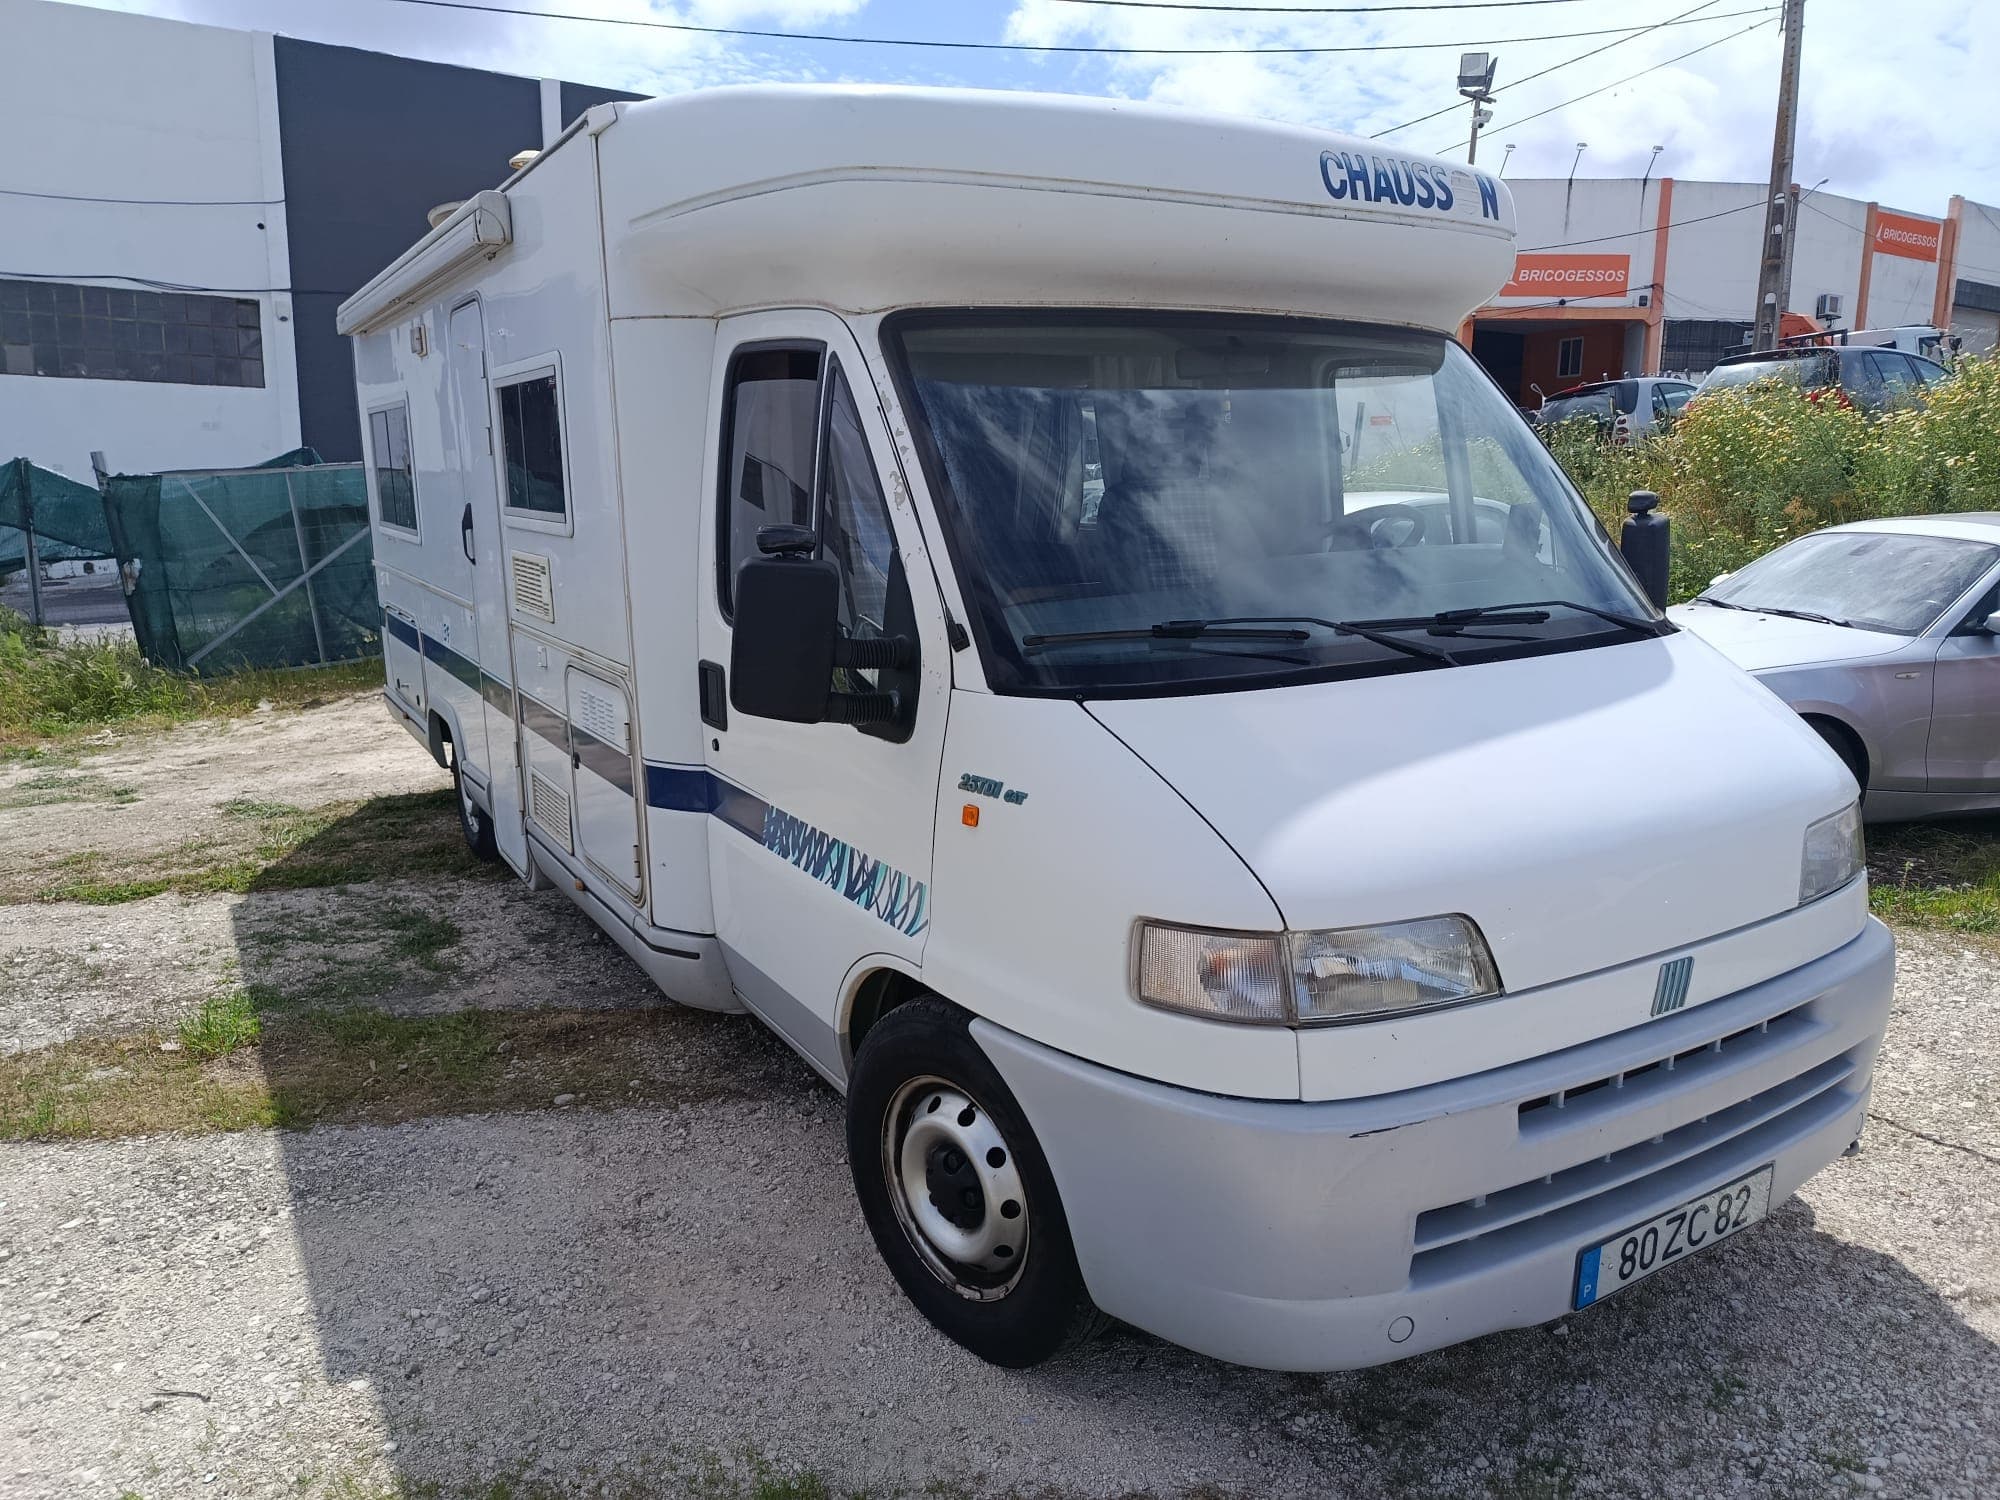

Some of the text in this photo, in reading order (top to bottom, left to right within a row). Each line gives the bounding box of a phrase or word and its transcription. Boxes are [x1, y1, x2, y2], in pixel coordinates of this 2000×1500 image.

[1320, 150, 1499, 221] CHAUSSN
[1883, 227, 1937, 248] BRICOGESSOS
[1518, 269, 1626, 282] BRICOGESSOS
[1583, 1284, 1592, 1298] P
